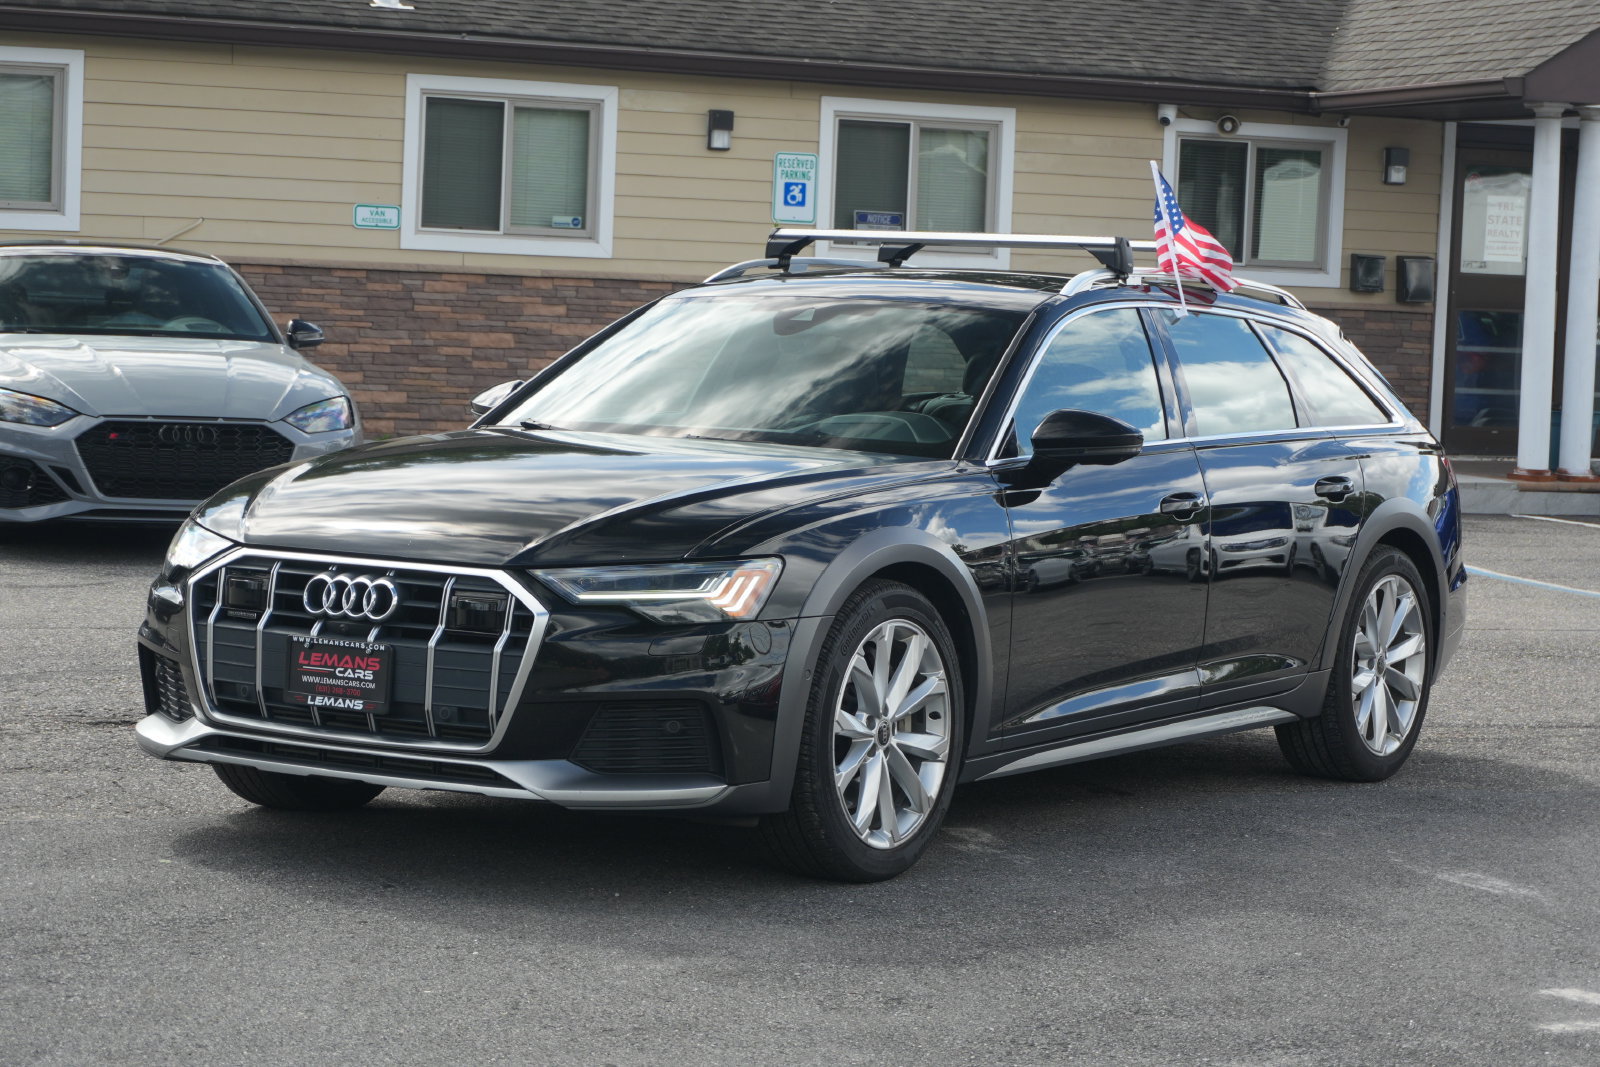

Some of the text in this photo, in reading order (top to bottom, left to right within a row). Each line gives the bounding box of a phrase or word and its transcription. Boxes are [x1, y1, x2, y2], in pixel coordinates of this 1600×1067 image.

[778, 158, 815, 169] RESERVED
[781, 169, 811, 181] PARKING
[866, 214, 891, 224] NOTICE
[1487, 214, 1523, 226] STATE
[1487, 229, 1521, 238] REALTY
[298, 651, 381, 671] LEMANS
[335, 667, 374, 680] CARS
[301, 675, 376, 689] WWW.LEMANSCARS.COM
[307, 695, 364, 710] LEMANS
